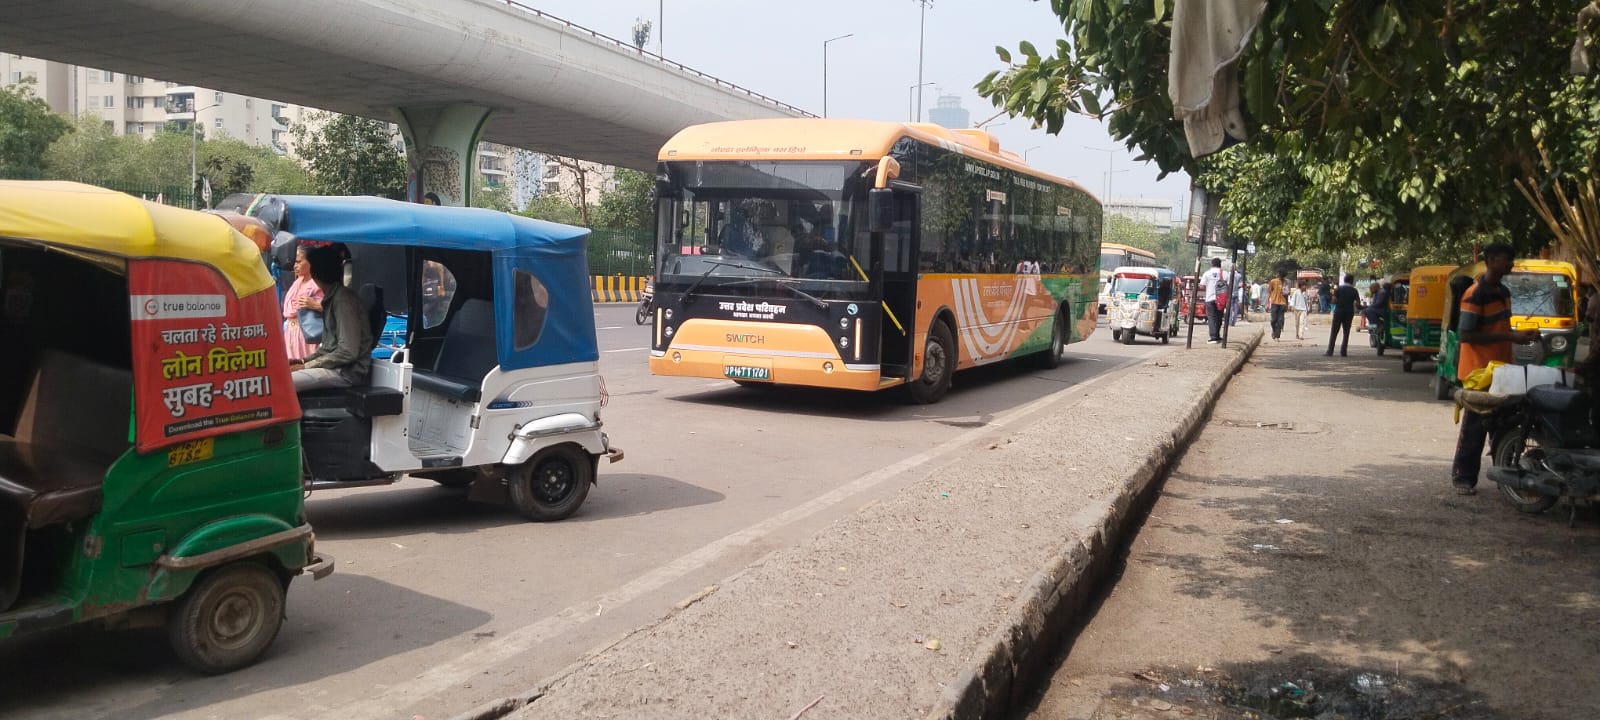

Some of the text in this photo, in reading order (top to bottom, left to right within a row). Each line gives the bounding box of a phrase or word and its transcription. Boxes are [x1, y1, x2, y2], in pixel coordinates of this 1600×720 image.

[163, 301, 221, 311] true balance
[719, 300, 786, 314] उत्तर प्रदेश परिवहन
[162, 323, 268, 344] चलता रहे तेरा काम,
[726, 333, 765, 344] SWITCH
[162, 345, 266, 379] लोन मिलेगा
[168, 420, 203, 433] Download
[203, 418, 215, 426] the
[230, 412, 255, 421] Balance
